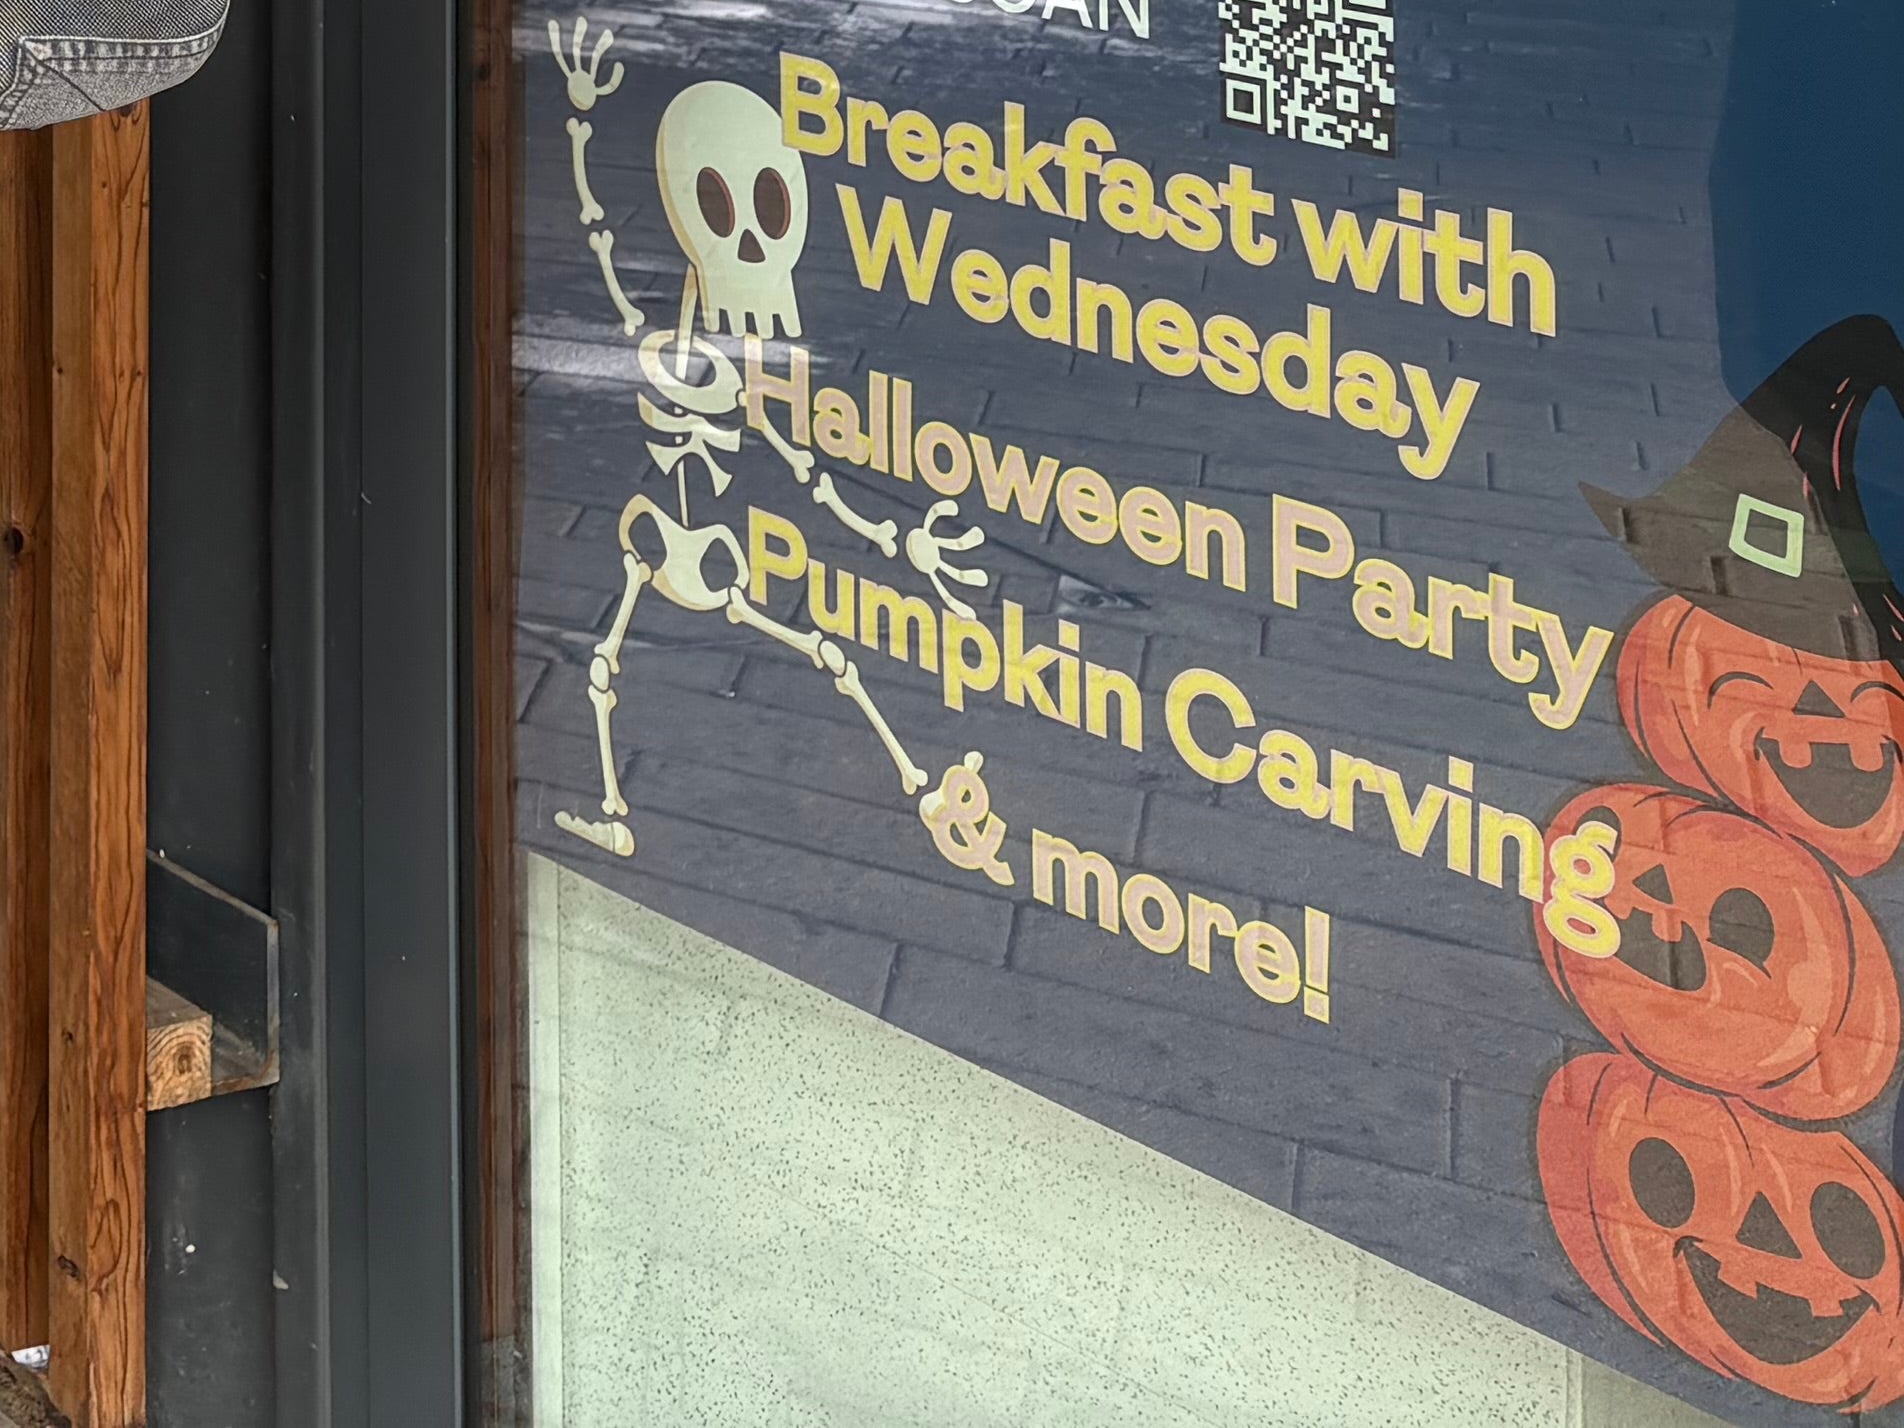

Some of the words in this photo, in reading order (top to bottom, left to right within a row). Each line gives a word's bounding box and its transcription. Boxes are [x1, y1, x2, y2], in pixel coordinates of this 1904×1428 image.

[778, 50, 1278, 268] Breakfast
[1295, 188, 1559, 339] with
[837, 186, 1482, 482] Wednesday
[743, 334, 1249, 591] Halloween
[1270, 496, 1618, 733] Party
[745, 512, 1145, 754] Pumpkin
[1164, 667, 1624, 958] Carving
[934, 761, 1015, 887] &
[1033, 825, 1333, 1025] more!
